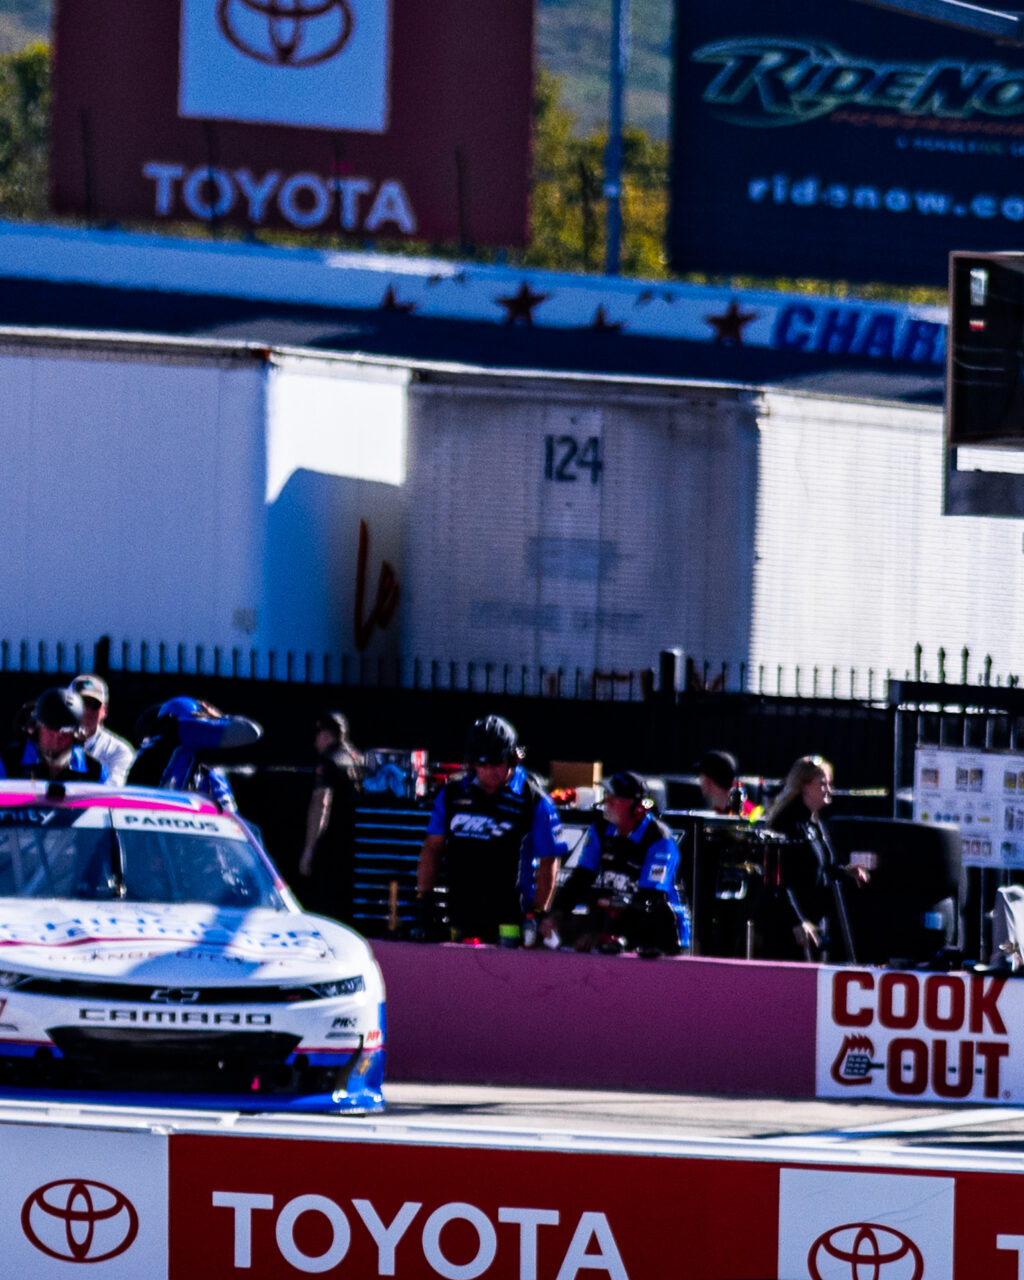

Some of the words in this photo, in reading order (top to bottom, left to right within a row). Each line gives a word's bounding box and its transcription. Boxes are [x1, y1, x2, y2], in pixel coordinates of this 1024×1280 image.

[143, 162, 417, 234] TOYOTA
[544, 434, 601, 485] 124
[124, 815, 220, 832] PARDUS
[79, 1008, 272, 1025] CAMARO
[831, 971, 1009, 1038] COOK
[888, 1037, 1010, 1099] OUT
